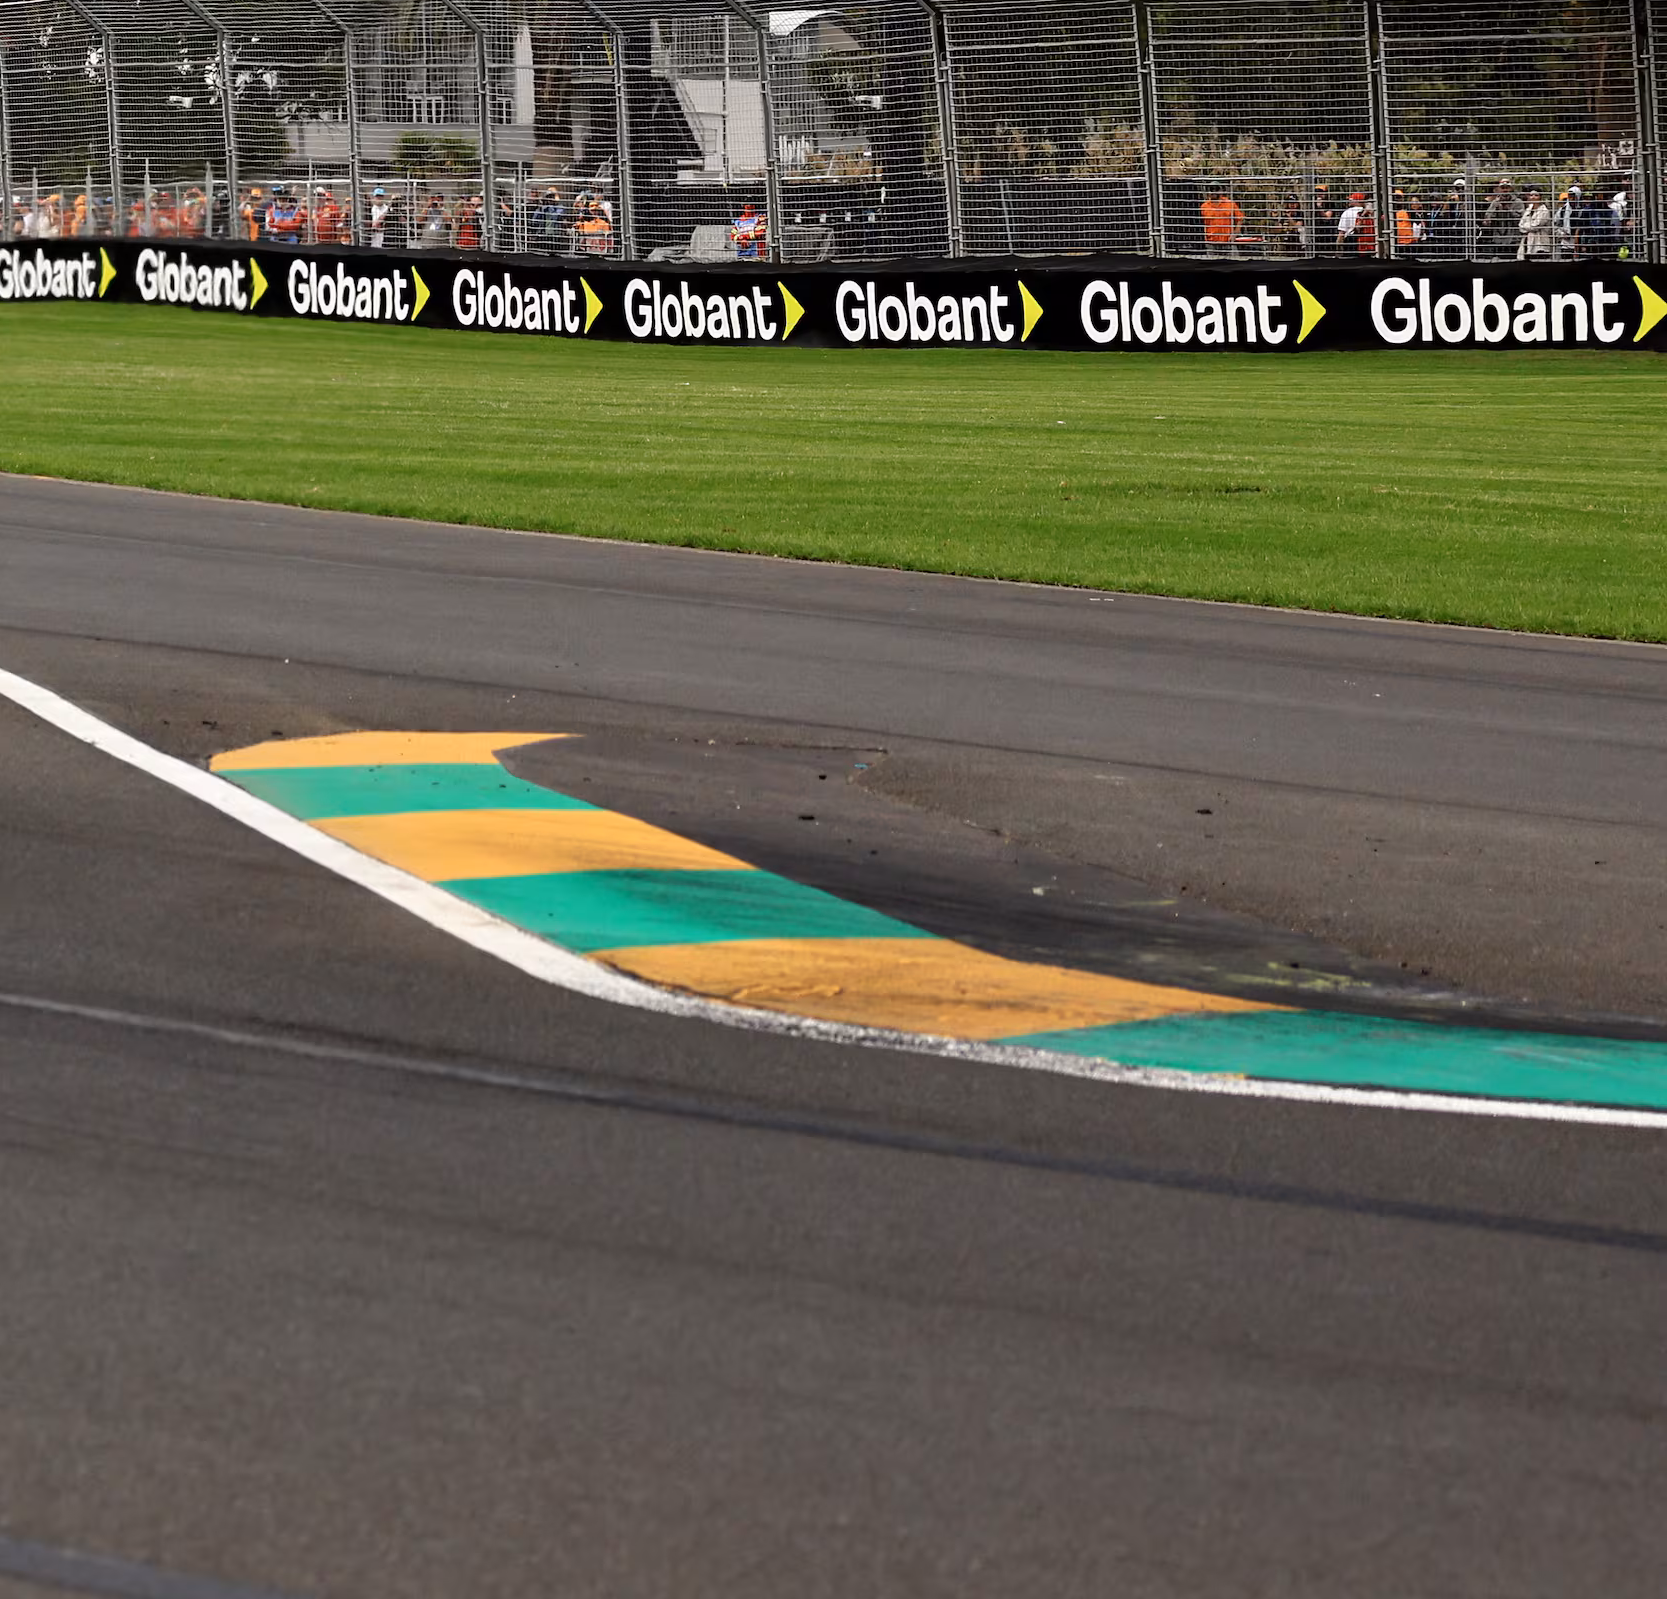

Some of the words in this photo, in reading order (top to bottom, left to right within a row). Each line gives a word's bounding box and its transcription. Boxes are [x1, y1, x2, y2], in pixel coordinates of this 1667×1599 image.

[135, 249, 248, 311] Globant
[288, 259, 409, 320] Globant
[453, 269, 579, 334] Globant
[624, 279, 777, 340] Globant
[1371, 277, 1625, 343] Globant
[836, 281, 1015, 342] Globant
[1080, 280, 1288, 344] Globant
